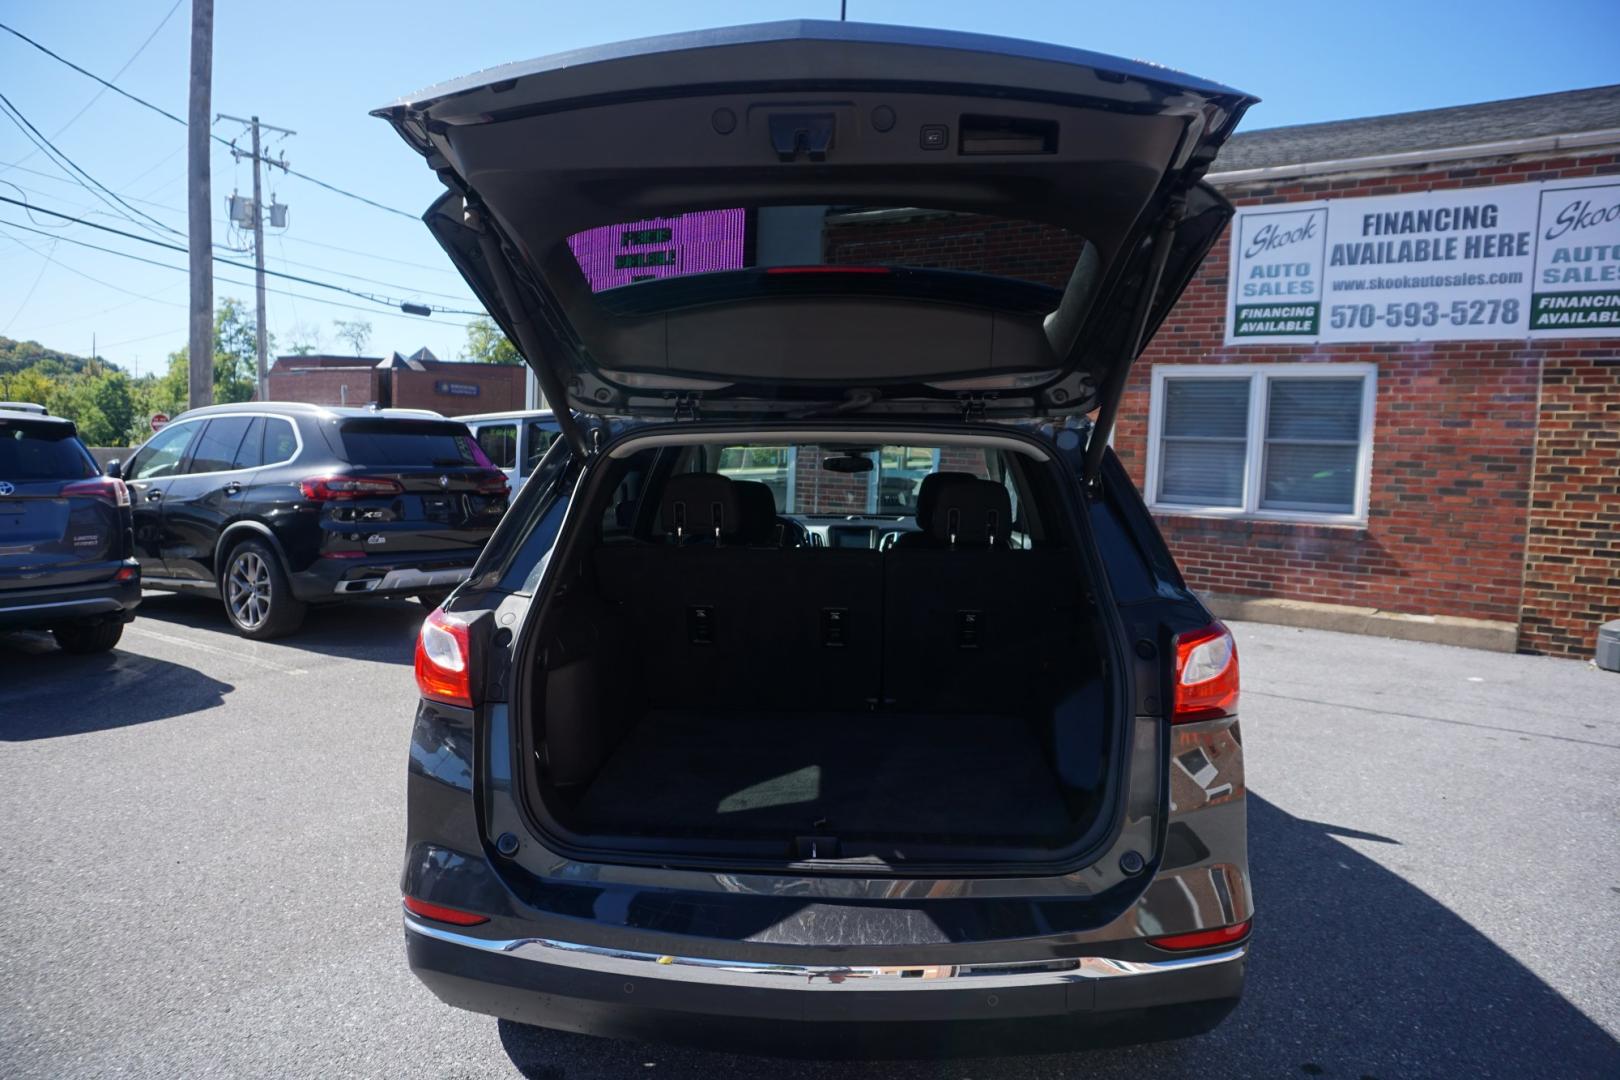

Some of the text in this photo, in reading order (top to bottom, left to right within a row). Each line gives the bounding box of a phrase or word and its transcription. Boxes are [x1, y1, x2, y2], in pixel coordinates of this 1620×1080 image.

[1362, 204, 1499, 236] FINANCING
[1545, 200, 1620, 240] Skoo
[1244, 213, 1317, 259] Skook
[1330, 231, 1531, 266] AVAILABLE HERE
[1250, 262, 1311, 279] AUTO
[1543, 264, 1620, 284] SALE
[1243, 280, 1314, 297] SALES
[1332, 271, 1523, 292] www.skookautosales.com
[1240, 306, 1315, 319] FINANCING
[1330, 298, 1520, 329] 570-593-5278
[1240, 321, 1313, 333] AVAILABLE
